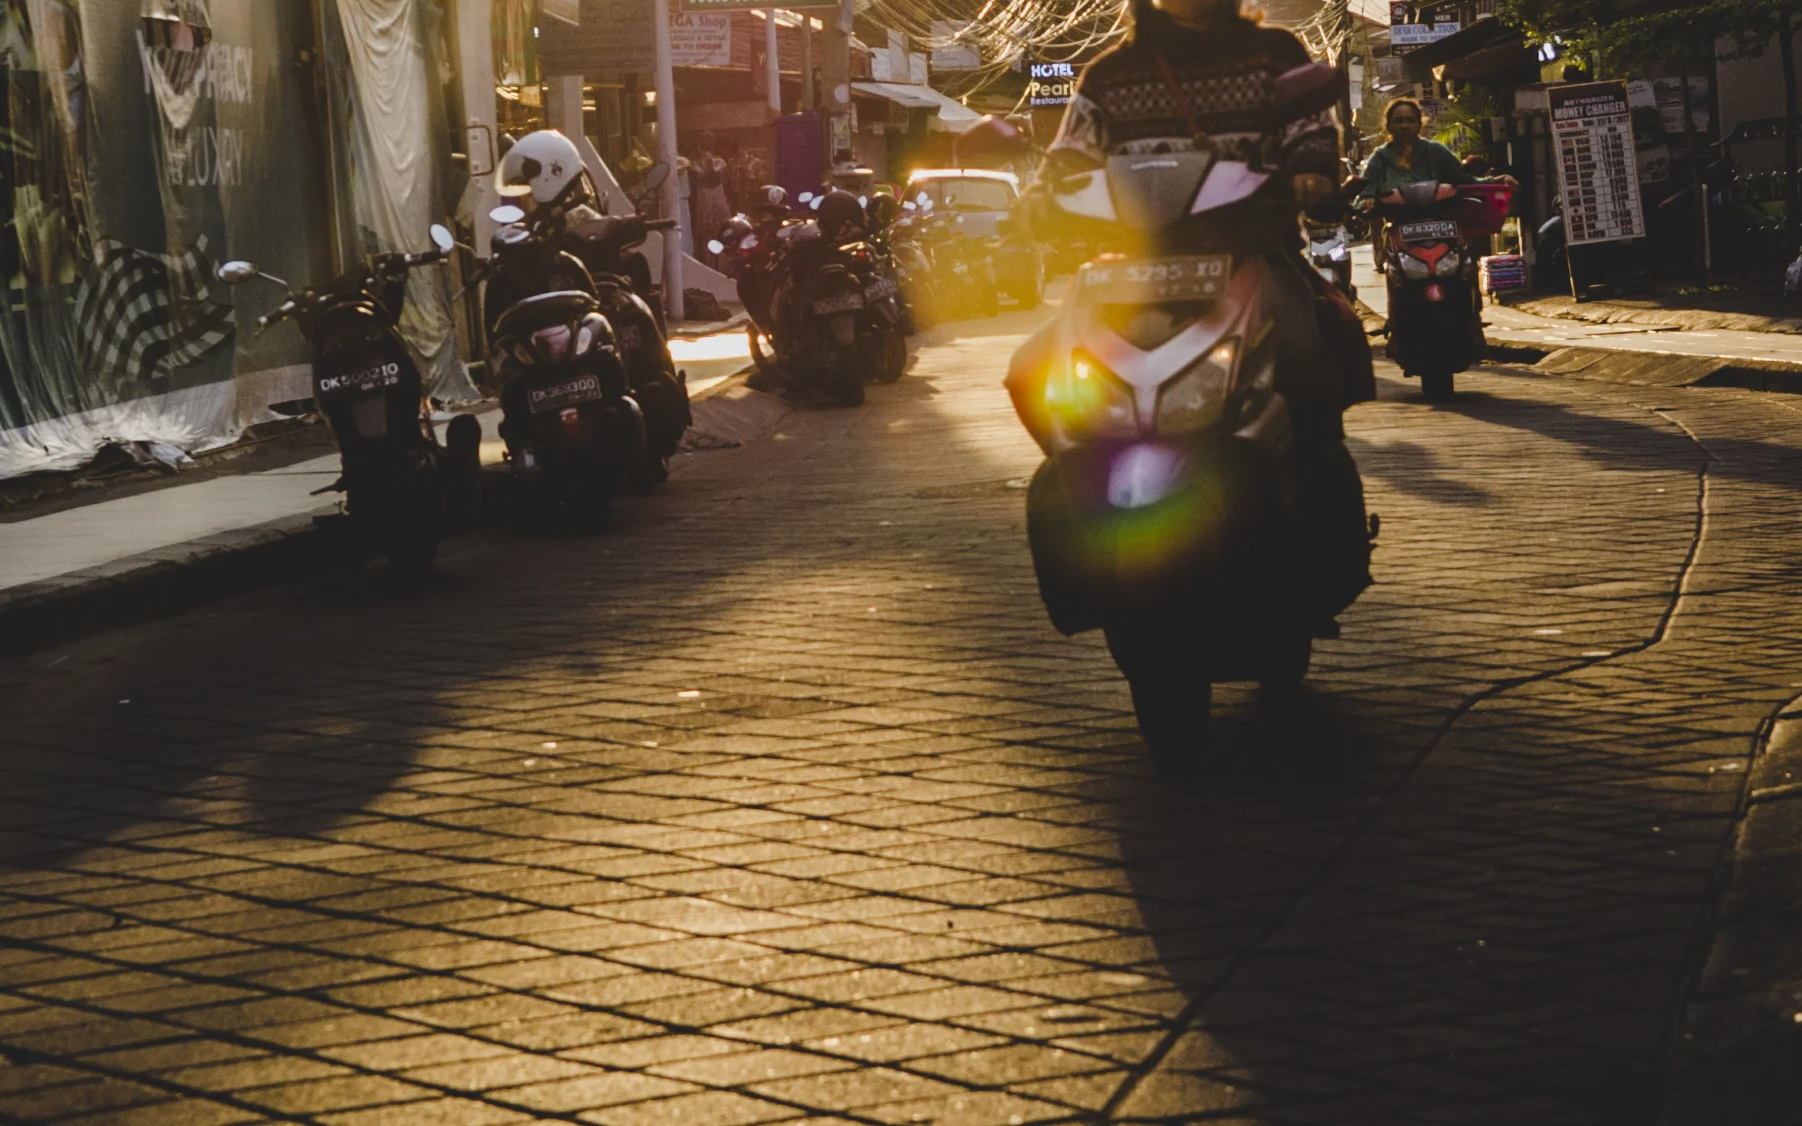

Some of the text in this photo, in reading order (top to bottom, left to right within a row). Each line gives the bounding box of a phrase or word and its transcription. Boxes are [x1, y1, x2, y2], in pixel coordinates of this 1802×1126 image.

[698, 13, 727, 29] Shop
[1031, 63, 1074, 77] HOTEL
[1031, 80, 1074, 97] Pearl
[1554, 101, 1626, 119] MONEY CHANGER
